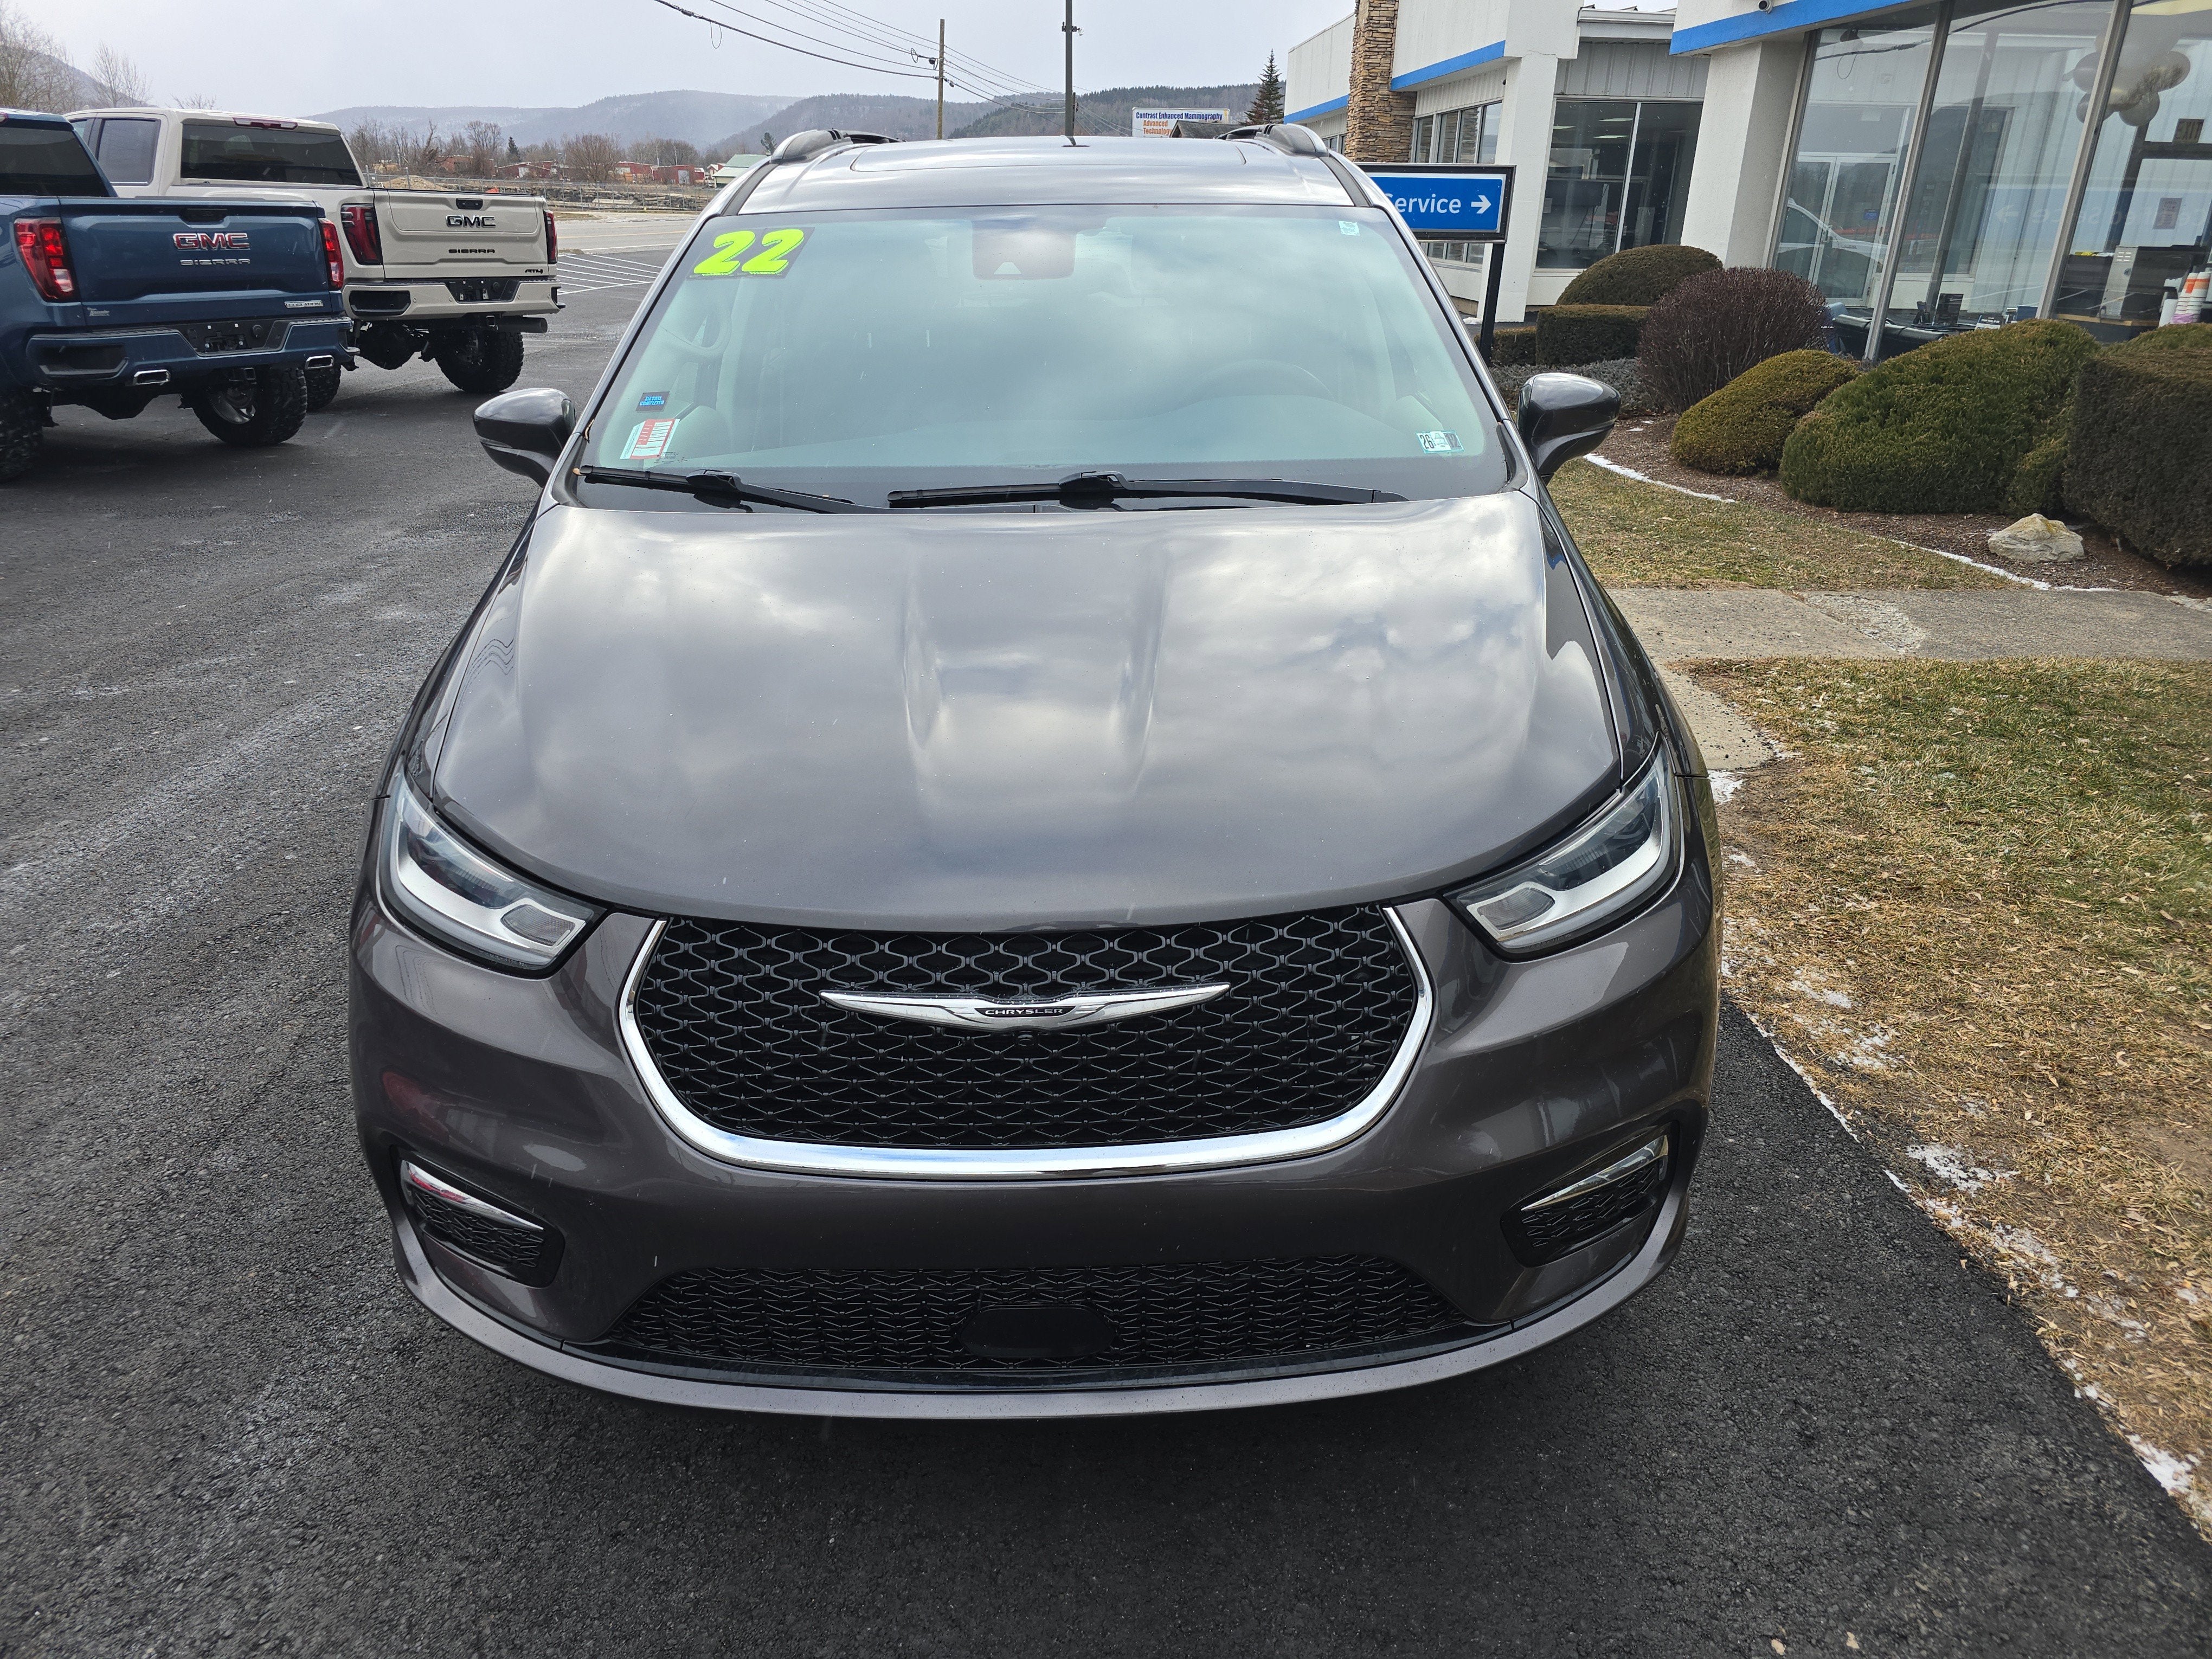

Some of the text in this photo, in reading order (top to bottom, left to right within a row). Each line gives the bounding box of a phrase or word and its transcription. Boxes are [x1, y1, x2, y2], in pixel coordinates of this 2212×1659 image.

[1185, 112, 1223, 121] Mammography
[1385, 193, 1461, 214] ervice
[446, 215, 496, 228] GMC
[172, 233, 250, 250] GMC
[694, 229, 805, 276] 22
[1419, 434, 1435, 449] 26
